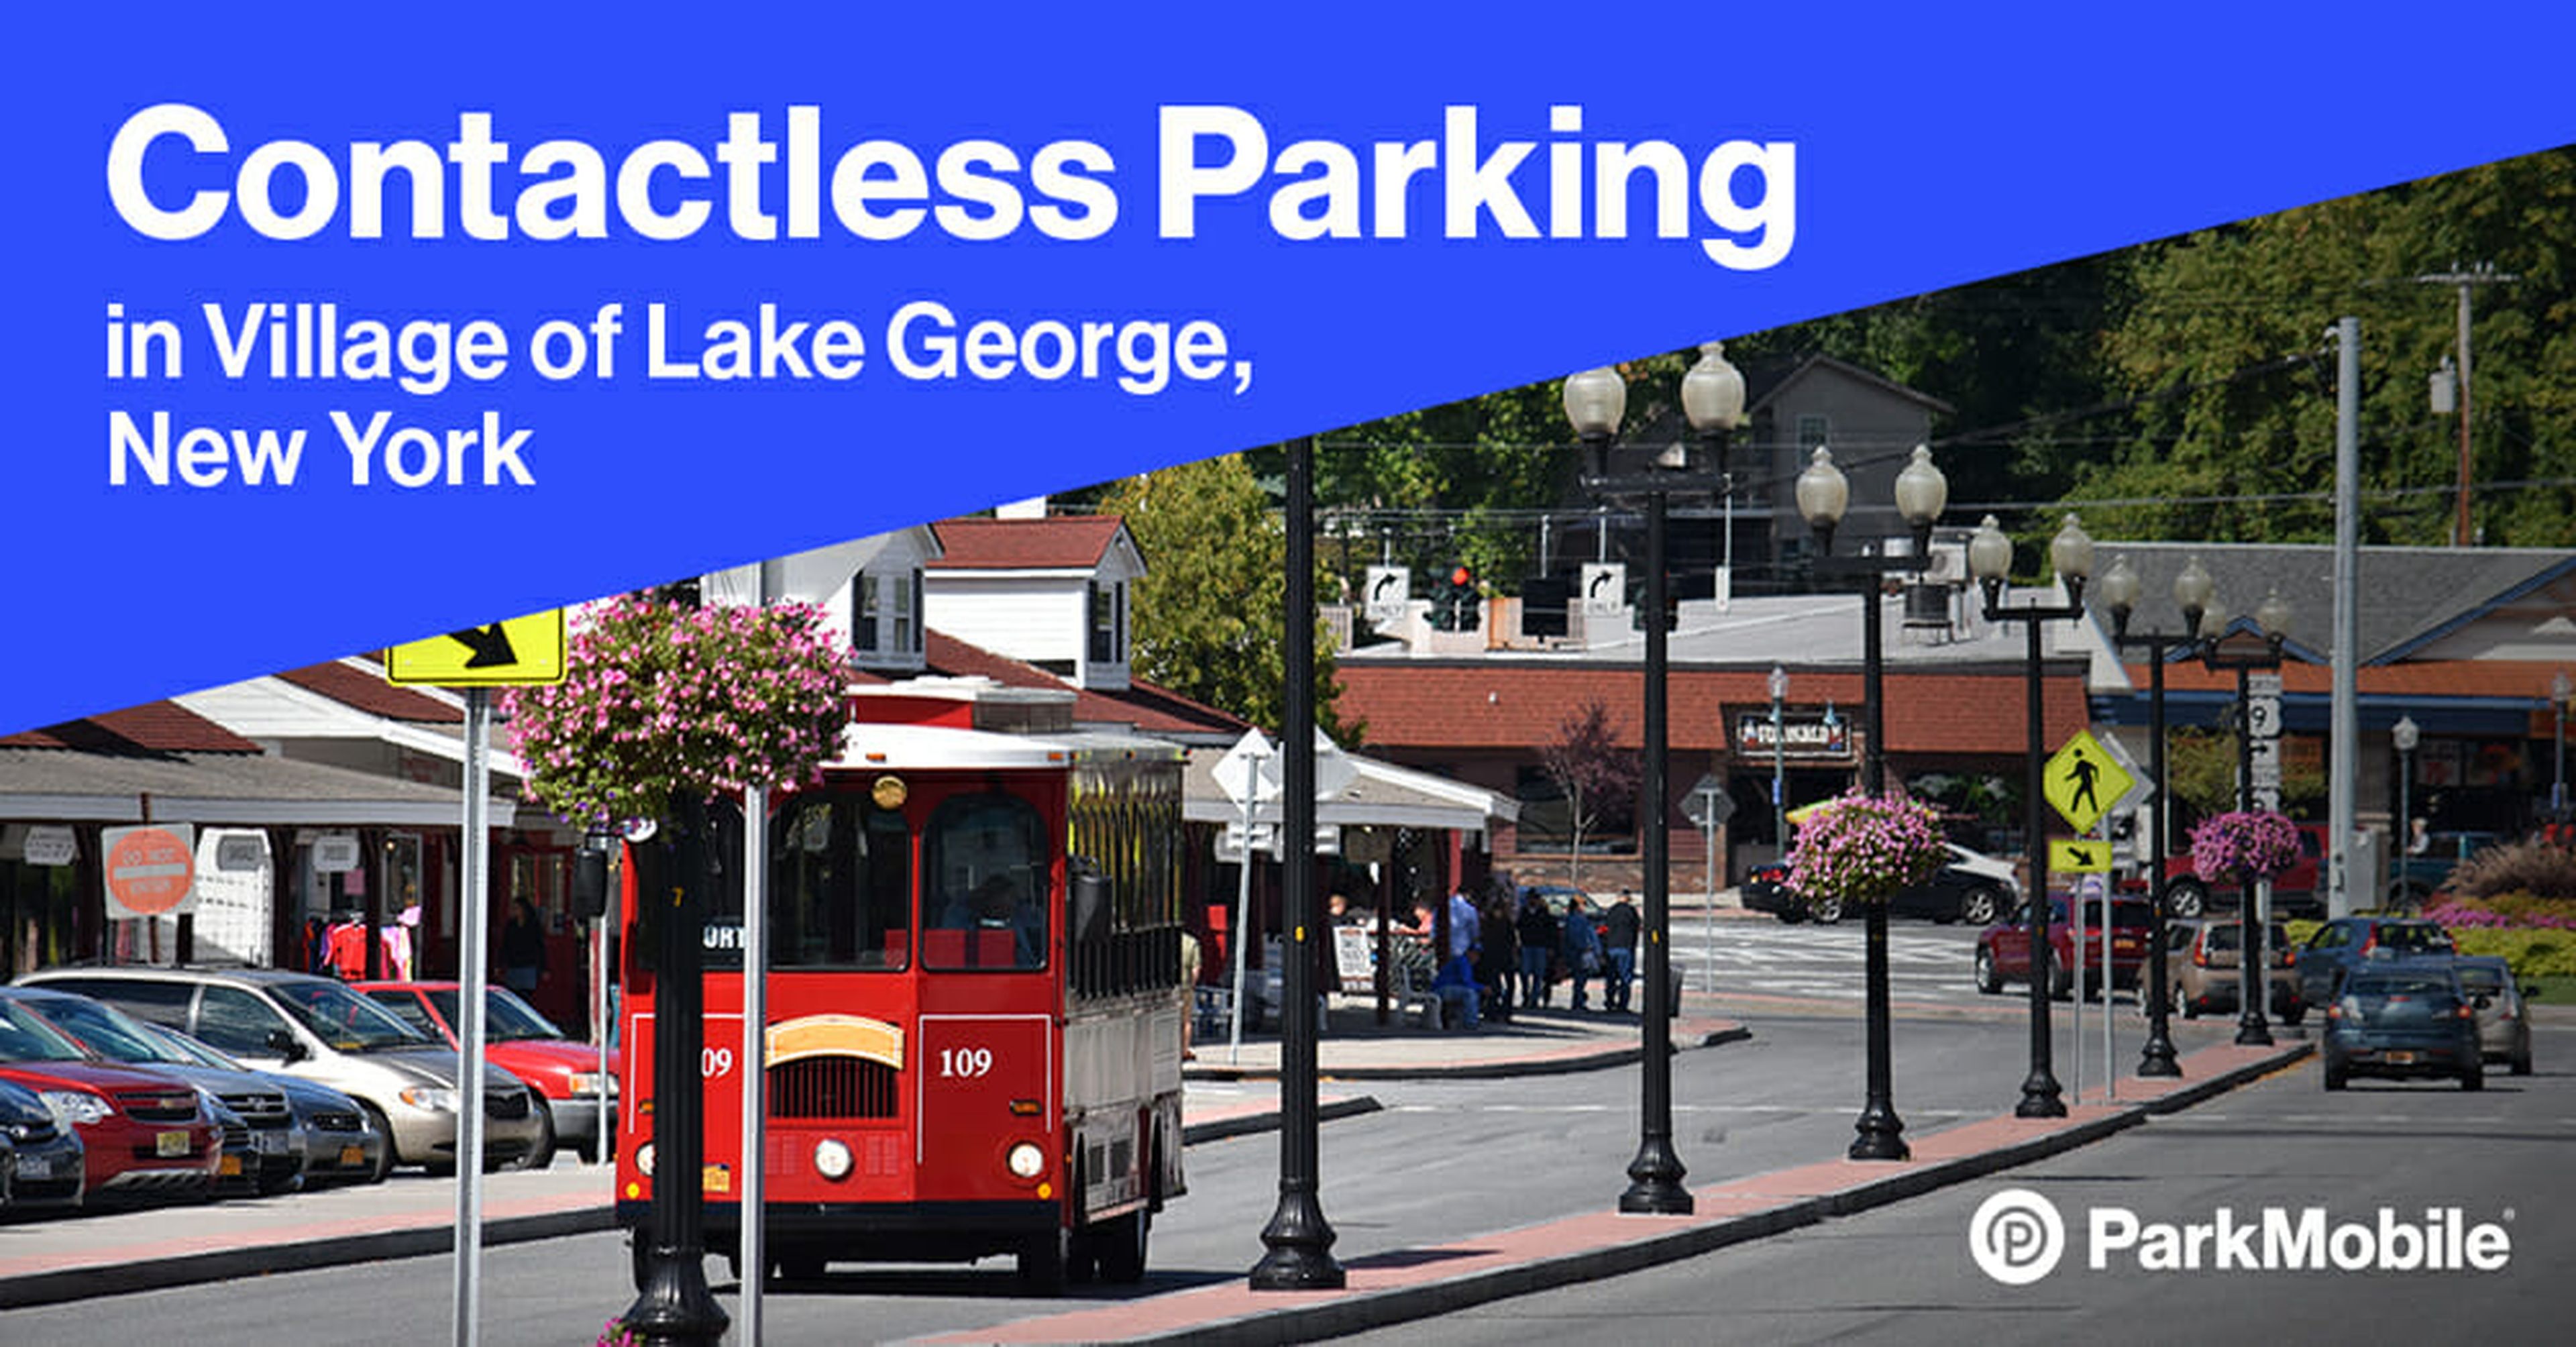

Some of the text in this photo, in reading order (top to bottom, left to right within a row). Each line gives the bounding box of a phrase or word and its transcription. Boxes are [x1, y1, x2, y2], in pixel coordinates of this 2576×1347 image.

[2251, 706, 2267, 728] 9
[122, 847, 176, 866] DO NOT
[701, 1047, 733, 1077] 09
[939, 1047, 993, 1078] 109
